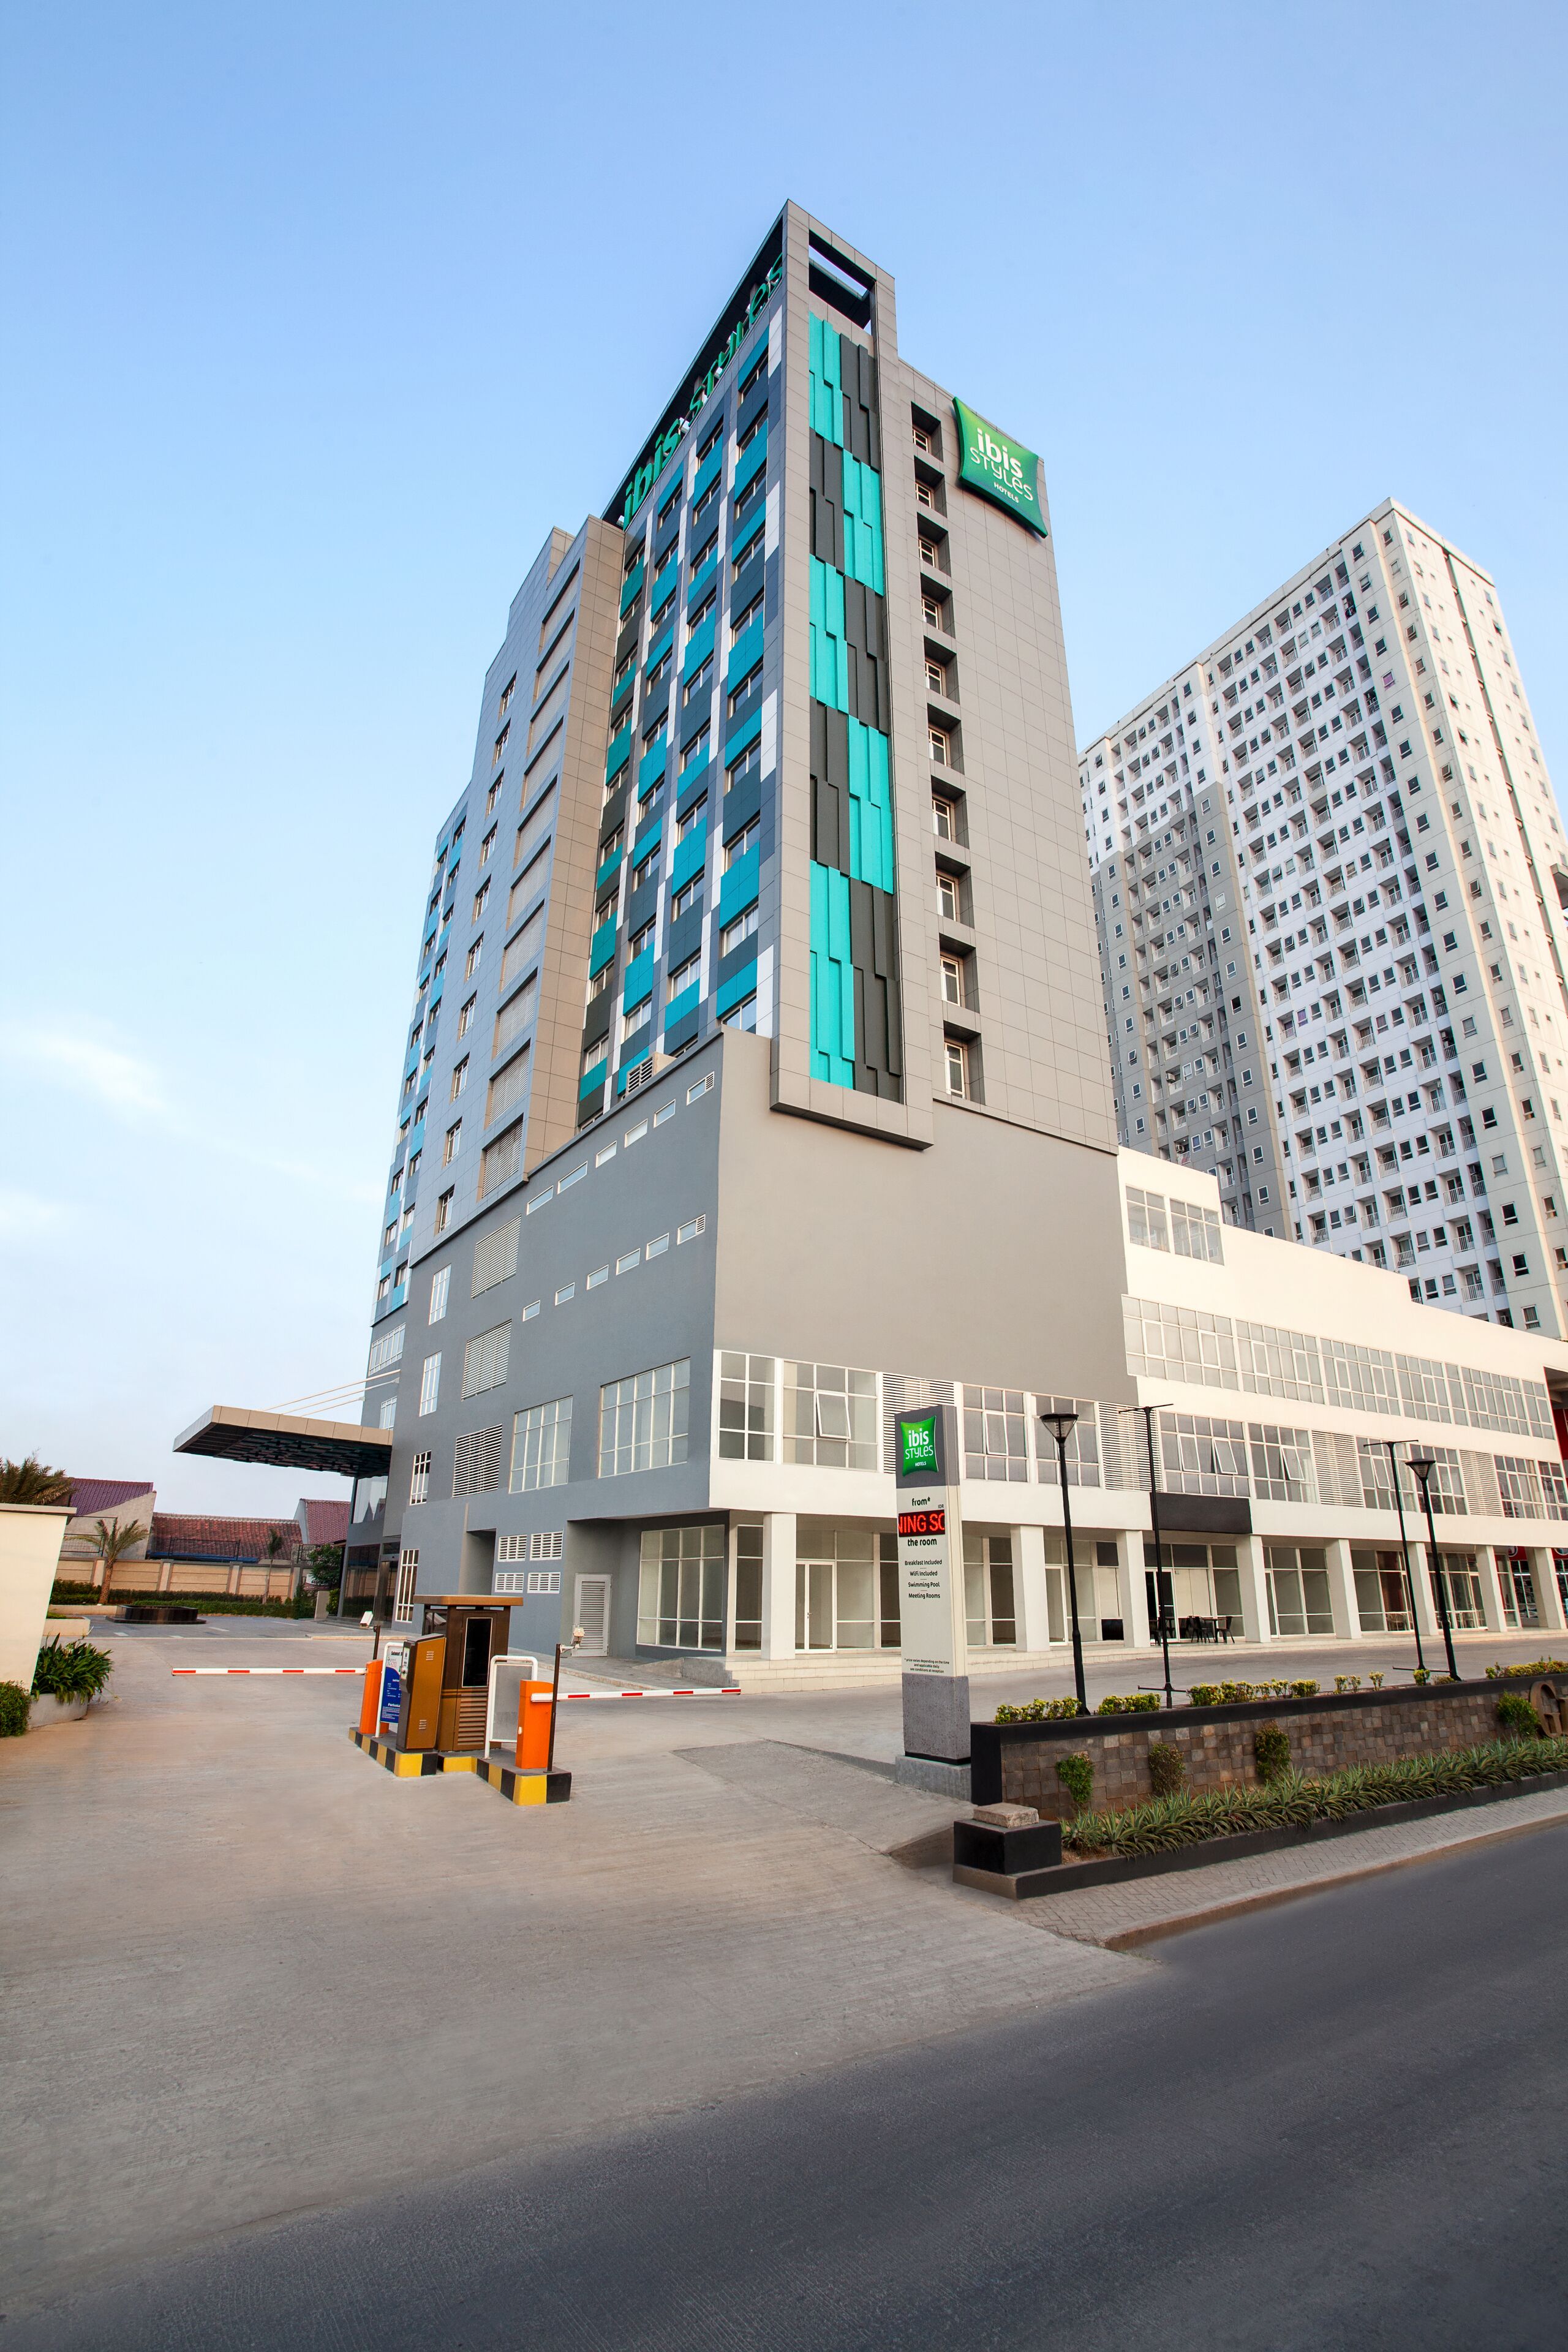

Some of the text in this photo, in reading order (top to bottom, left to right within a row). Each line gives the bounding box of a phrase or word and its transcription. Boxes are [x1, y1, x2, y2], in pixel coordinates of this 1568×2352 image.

[977, 428, 1023, 478] ibis
[623, 418, 681, 530] ibis
[993, 481, 1019, 503] HOTELS
[908, 1428, 930, 1447] ibis
[907, 1538, 918, 1547] the
